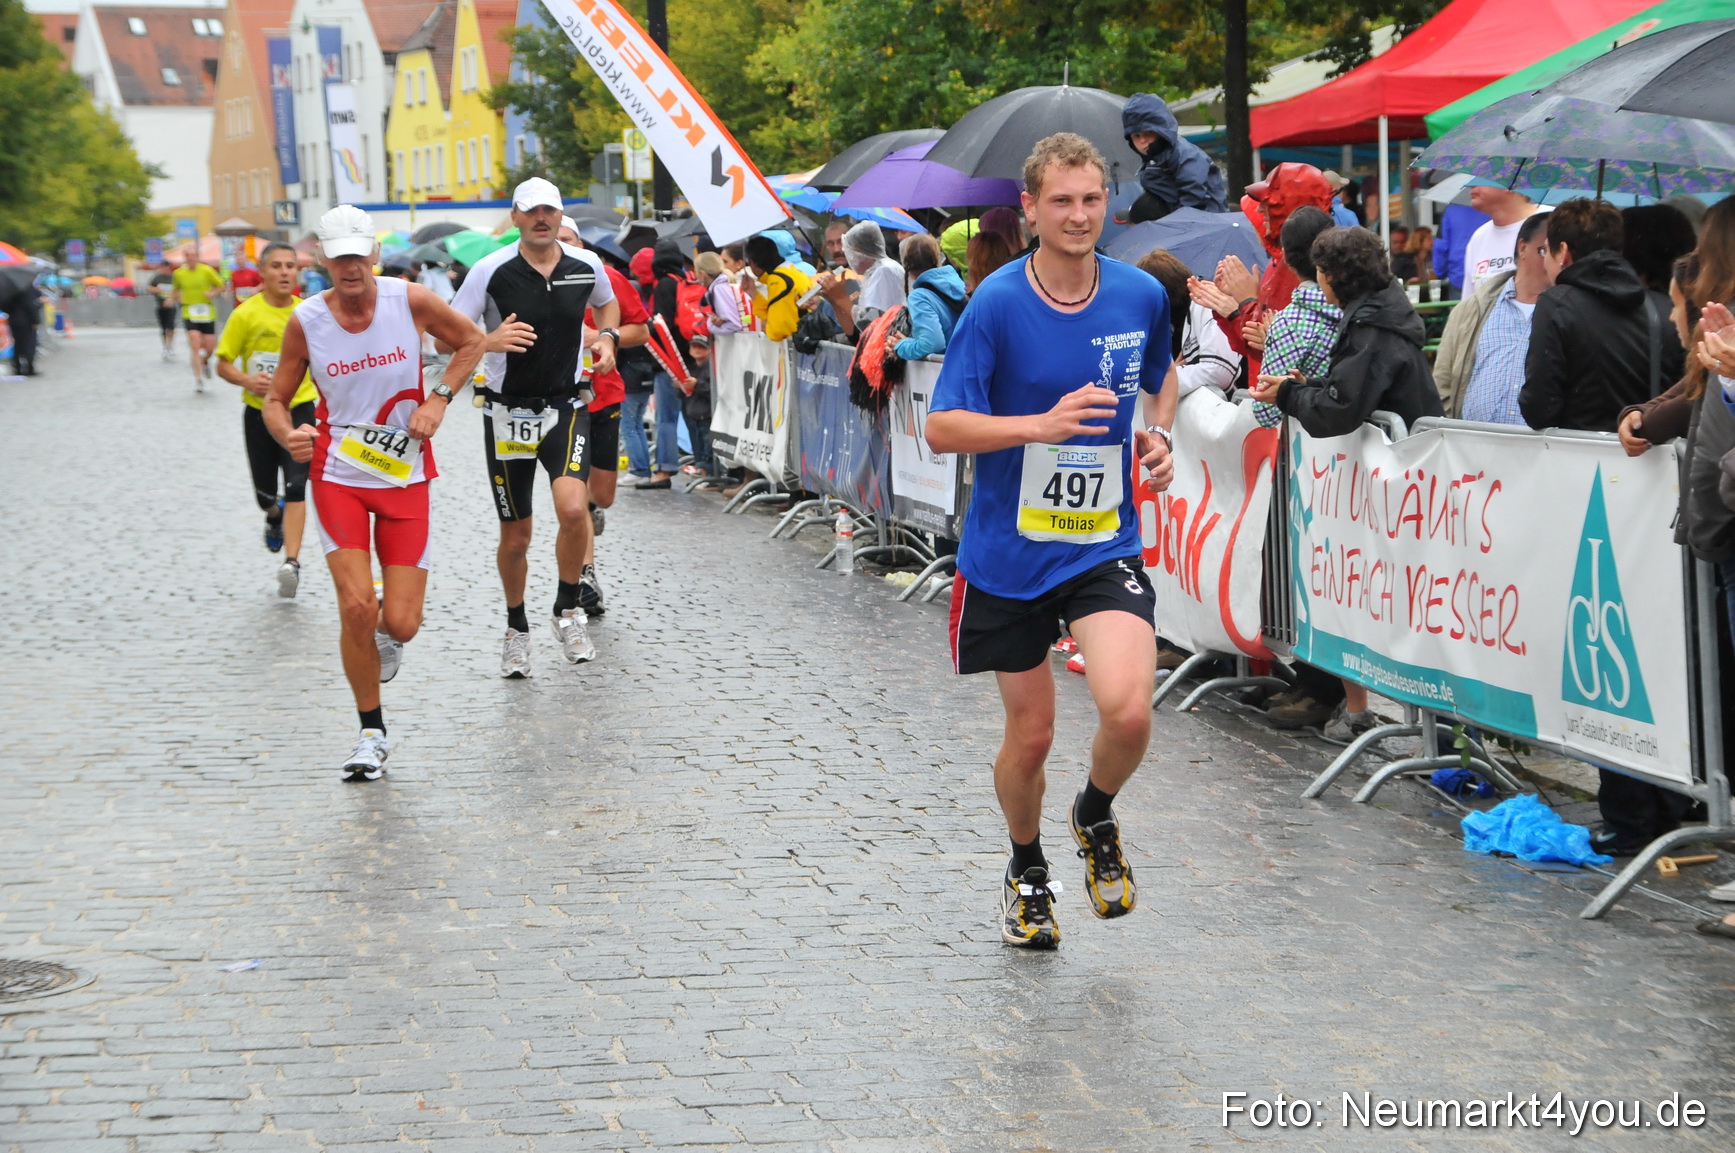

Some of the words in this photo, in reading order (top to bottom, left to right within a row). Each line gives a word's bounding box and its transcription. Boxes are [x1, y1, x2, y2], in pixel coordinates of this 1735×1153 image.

[1091, 337, 1105, 346] 12.
[1104, 330, 1146, 342] NEUMARKTER
[1104, 339, 1141, 351] STADTLAUF
[326, 346, 407, 377] Oberbank
[506, 420, 543, 442] 161
[359, 449, 391, 470] Martin
[1056, 451, 1098, 463] BOCK
[1042, 472, 1105, 508] 497
[1350, 460, 1381, 534] UNS
[1050, 515, 1095, 530] Tobias
[1405, 564, 1527, 657] BESSER.
[1565, 712, 1580, 734] Jura
[1634, 732, 1659, 758] GmbH
